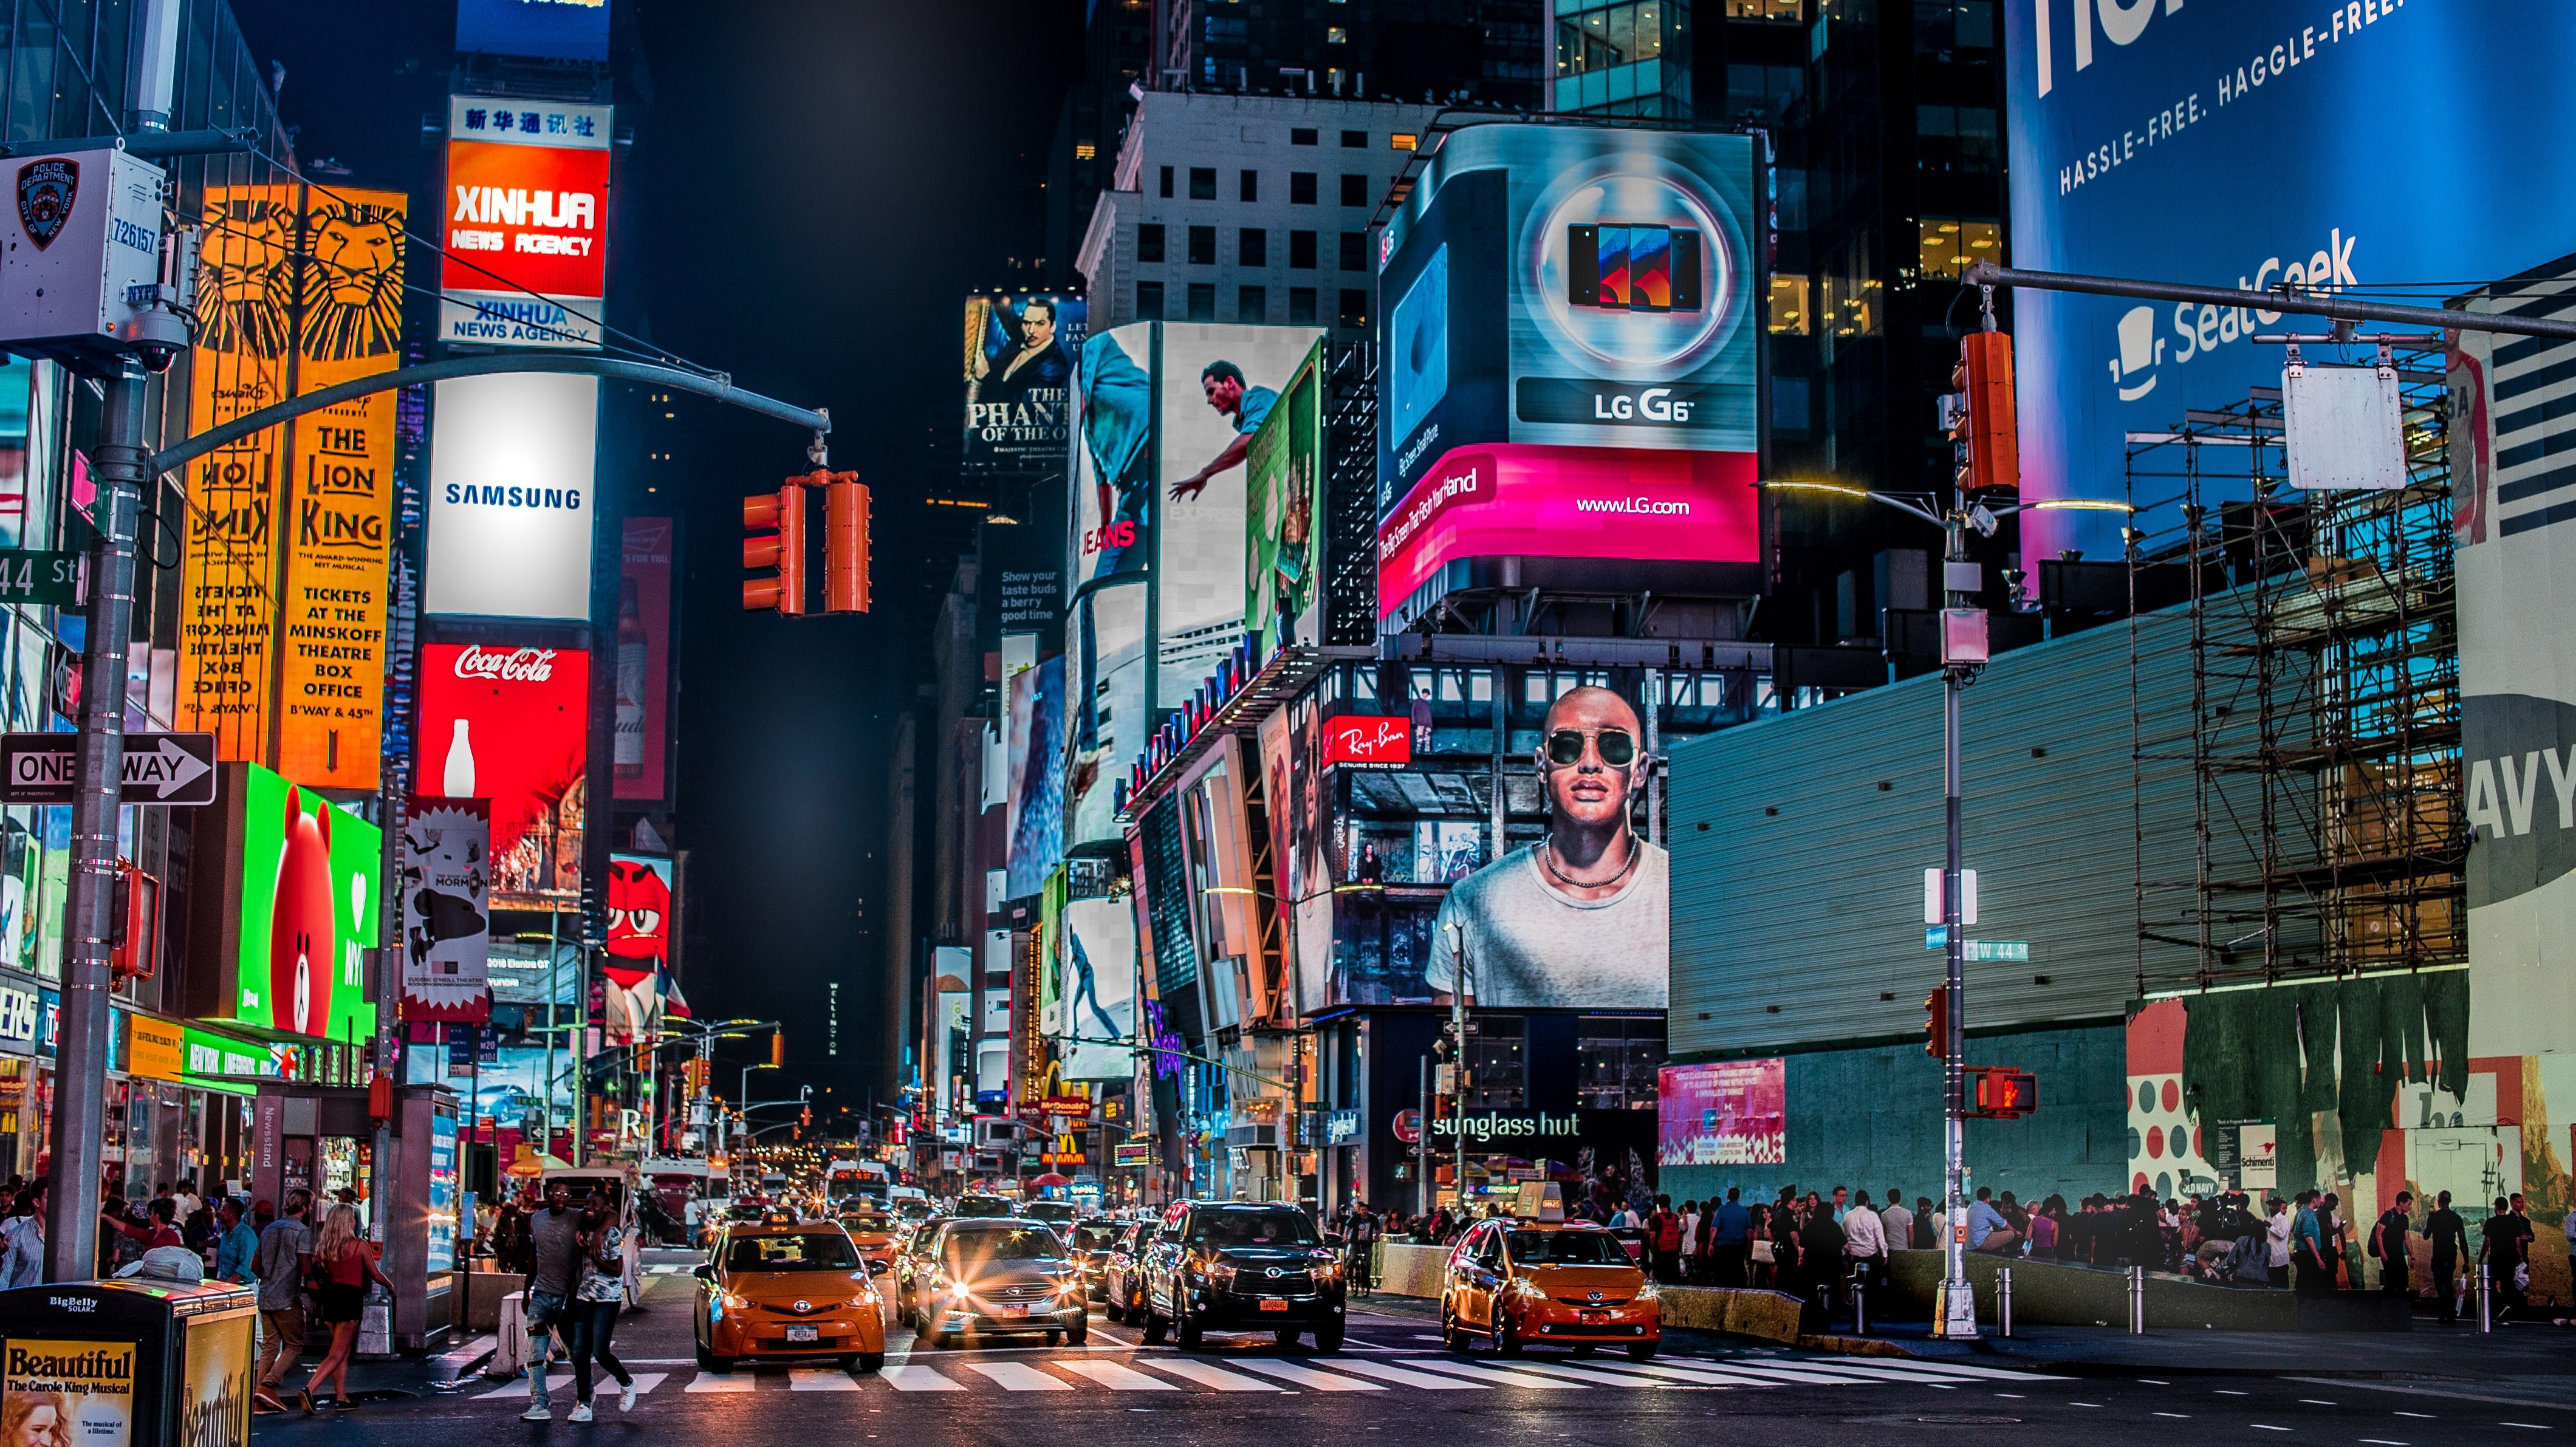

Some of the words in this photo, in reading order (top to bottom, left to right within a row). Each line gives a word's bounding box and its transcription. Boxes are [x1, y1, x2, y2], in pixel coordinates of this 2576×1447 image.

[2060, 92, 2207, 196] HASSLE-FREE.
[2218, 0, 2404, 106] HAGGLE-FREE.
[465, 108, 595, 138] 新华通讯社
[33, 163, 65, 174] POLICE
[21, 173, 75, 190] DEPARTMENT
[21, 200, 30, 221] CITY
[28, 223, 37, 234] OF
[48, 221, 63, 238] NEW
[61, 190, 74, 215] YORK
[453, 185, 595, 230] XINHUA
[451, 229, 504, 251] NEWS
[515, 233, 593, 256] AGENCY
[127, 284, 160, 302] NYPD
[474, 300, 567, 326] XINHUA
[453, 321, 507, 338] NEWS
[511, 325, 589, 343] AGENCY
[1029, 388, 1068, 402] THE
[323, 408, 367, 417] PRESENTS
[1594, 394, 1633, 420] LG
[318, 426, 366, 451] THE
[981, 427, 1006, 442] OF
[1010, 426, 1049, 440] THE
[309, 454, 375, 495] LION
[1444, 467, 1476, 499] Hand
[445, 483, 581, 510] SAMSUNG
[1576, 496, 1690, 516] www.LG.com
[300, 498, 383, 547] KING
[1083, 519, 1136, 557] JEANS
[315, 553, 383, 564] AWARD-WINNING
[0, 558, 34, 597] 44
[52, 559, 75, 583] St
[1002, 572, 1031, 582] Show
[1033, 572, 1057, 583] your
[303, 587, 371, 604] TICKETS
[1001, 585, 1029, 595] taste
[1030, 583, 1057, 594] buds
[1001, 599, 1008, 607] a
[1010, 597, 1042, 608] berry
[307, 607, 328, 620] AT
[334, 608, 366, 623] THE
[1001, 610, 1027, 623] good
[1029, 609, 1053, 620] time
[289, 624, 382, 643] MINSKOFF
[298, 644, 371, 662] THEATRE
[315, 663, 353, 679] BOX
[303, 683, 363, 699] OFFICE
[290, 705, 331, 717] B'WAY
[335, 707, 344, 717] &
[1339, 721, 1405, 756] Ray-Ban
[18, 755, 76, 782] ONE
[122, 755, 185, 781] WAY
[2465, 744, 2576, 840] AVY
[1979, 943, 1991, 958] W
[1997, 943, 2013, 959] 44
[2018, 943, 2027, 954] St
[487, 959, 507, 968] 2018
[0, 987, 39, 1041] ERS
[1041, 1101, 1090, 1110] McDonald's
[1433, 1111, 1536, 1143] sunglass
[1540, 1111, 1580, 1136] hut
[263, 1107, 275, 1168] Newsstand
[2241, 1156, 2275, 1168] Schimenti
[2196, 1183, 2214, 1194] NAVY
[49, 1296, 98, 1307] BigBelly
[7, 1347, 132, 1380] Beautiful
[7, 1380, 27, 1392] The
[29, 1380, 63, 1393] Carole
[64, 1381, 89, 1396] King
[91, 1382, 130, 1395] Musical
